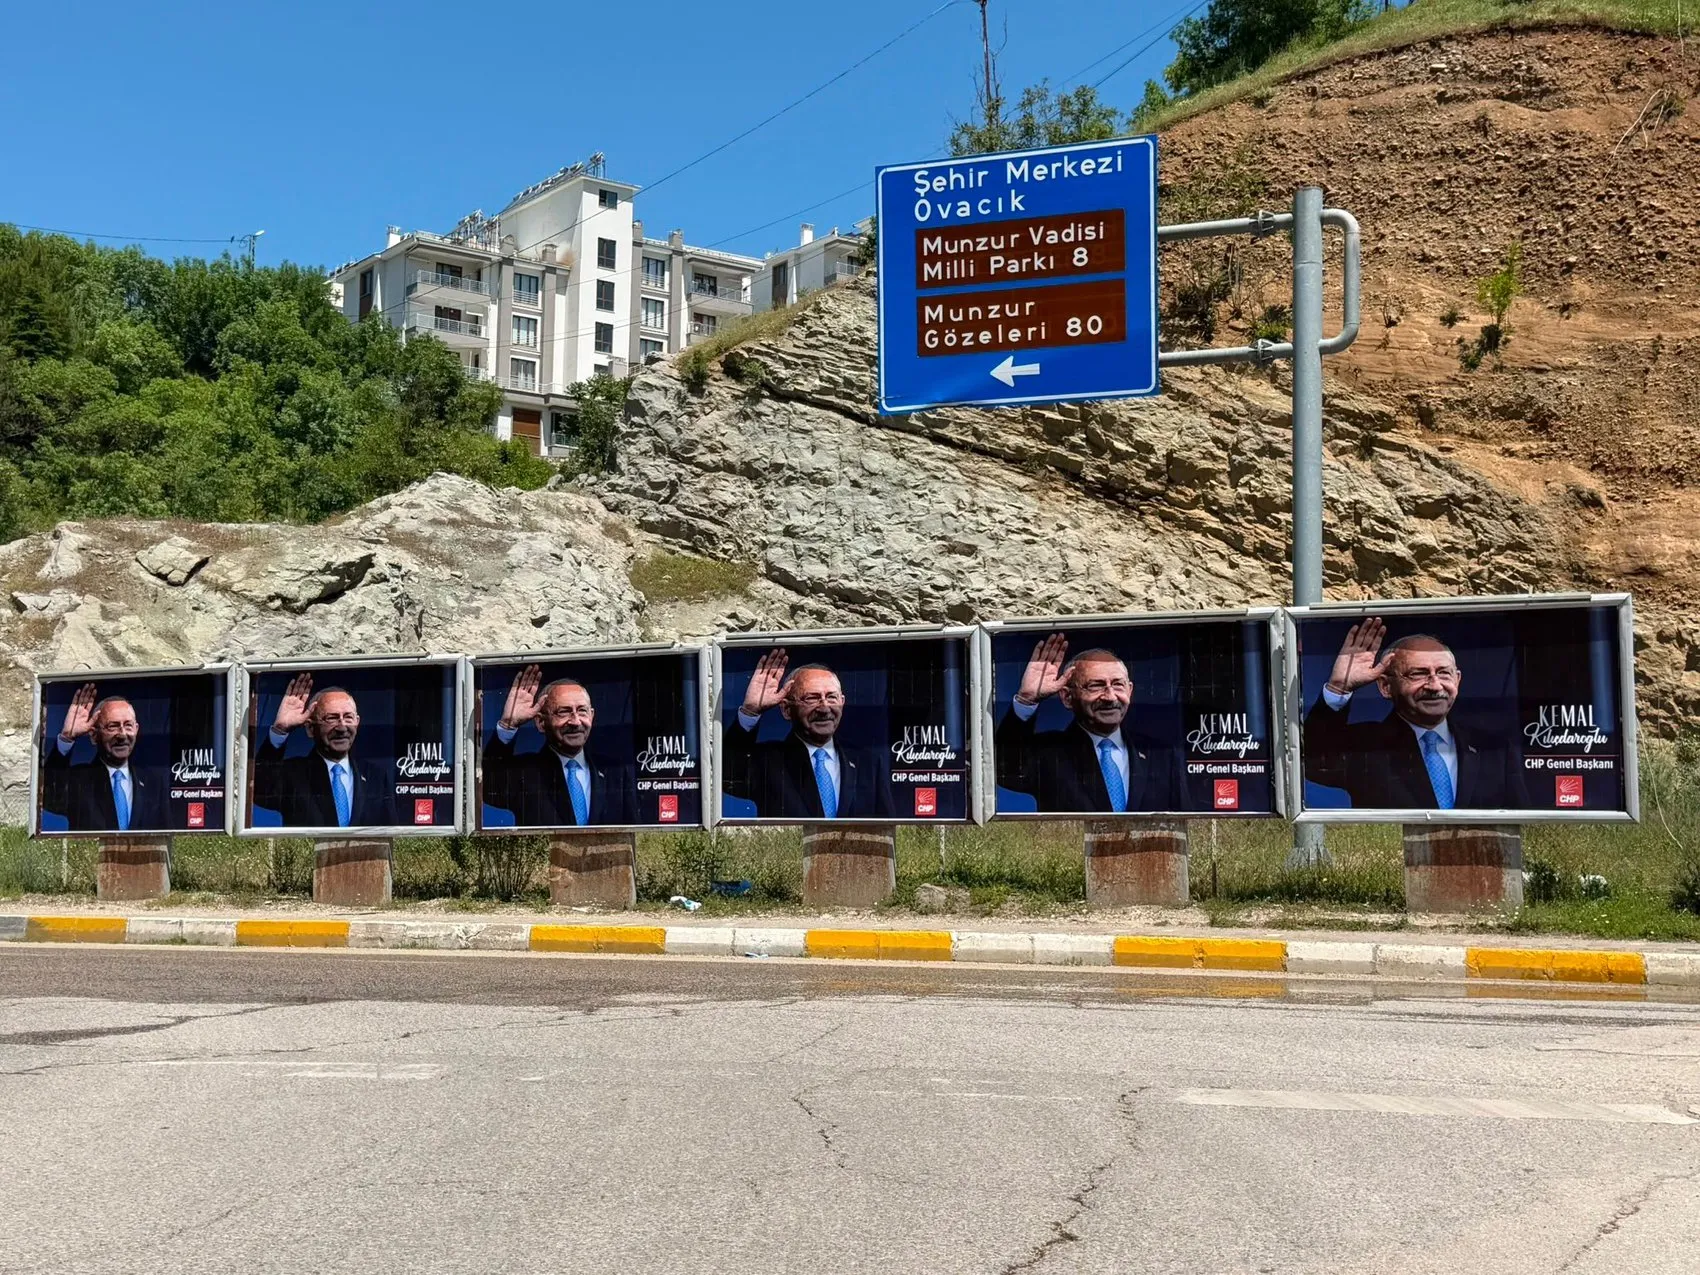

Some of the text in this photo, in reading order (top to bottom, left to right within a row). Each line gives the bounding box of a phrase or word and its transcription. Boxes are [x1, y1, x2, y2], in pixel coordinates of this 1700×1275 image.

[914, 150, 1123, 198] Şehir Merkezi
[914, 189, 1026, 222] Ovacık
[923, 221, 1105, 256] Munzur Vadisi
[923, 246, 1089, 282] Milli Parkı 8
[924, 301, 1036, 325] Munzur
[924, 315, 1103, 349] Gözeleri 80
[1200, 713, 1250, 734] KEMAL
[1539, 704, 1597, 727] KEMAL
[647, 735, 688, 755] KEMAL
[904, 725, 948, 745] KEMAL
[1186, 729, 1260, 759] Kılıçdaroğlu
[1523, 722, 1608, 753] Kılıçdaroğlu
[181, 748, 215, 766] KEMAL
[407, 742, 444, 761] KEMAL
[1187, 764, 1265, 774] CHP Genel Başkanı
[1524, 758, 1613, 770] CHP Genel Başkanı
[637, 781, 652, 790] CHP
[652, 781, 672, 790] Genel
[891, 773, 960, 783] CHP Genel Başkanı
[170, 790, 183, 798] CHP
[395, 786, 409, 794] CHP
[1559, 794, 1580, 803] CHP
